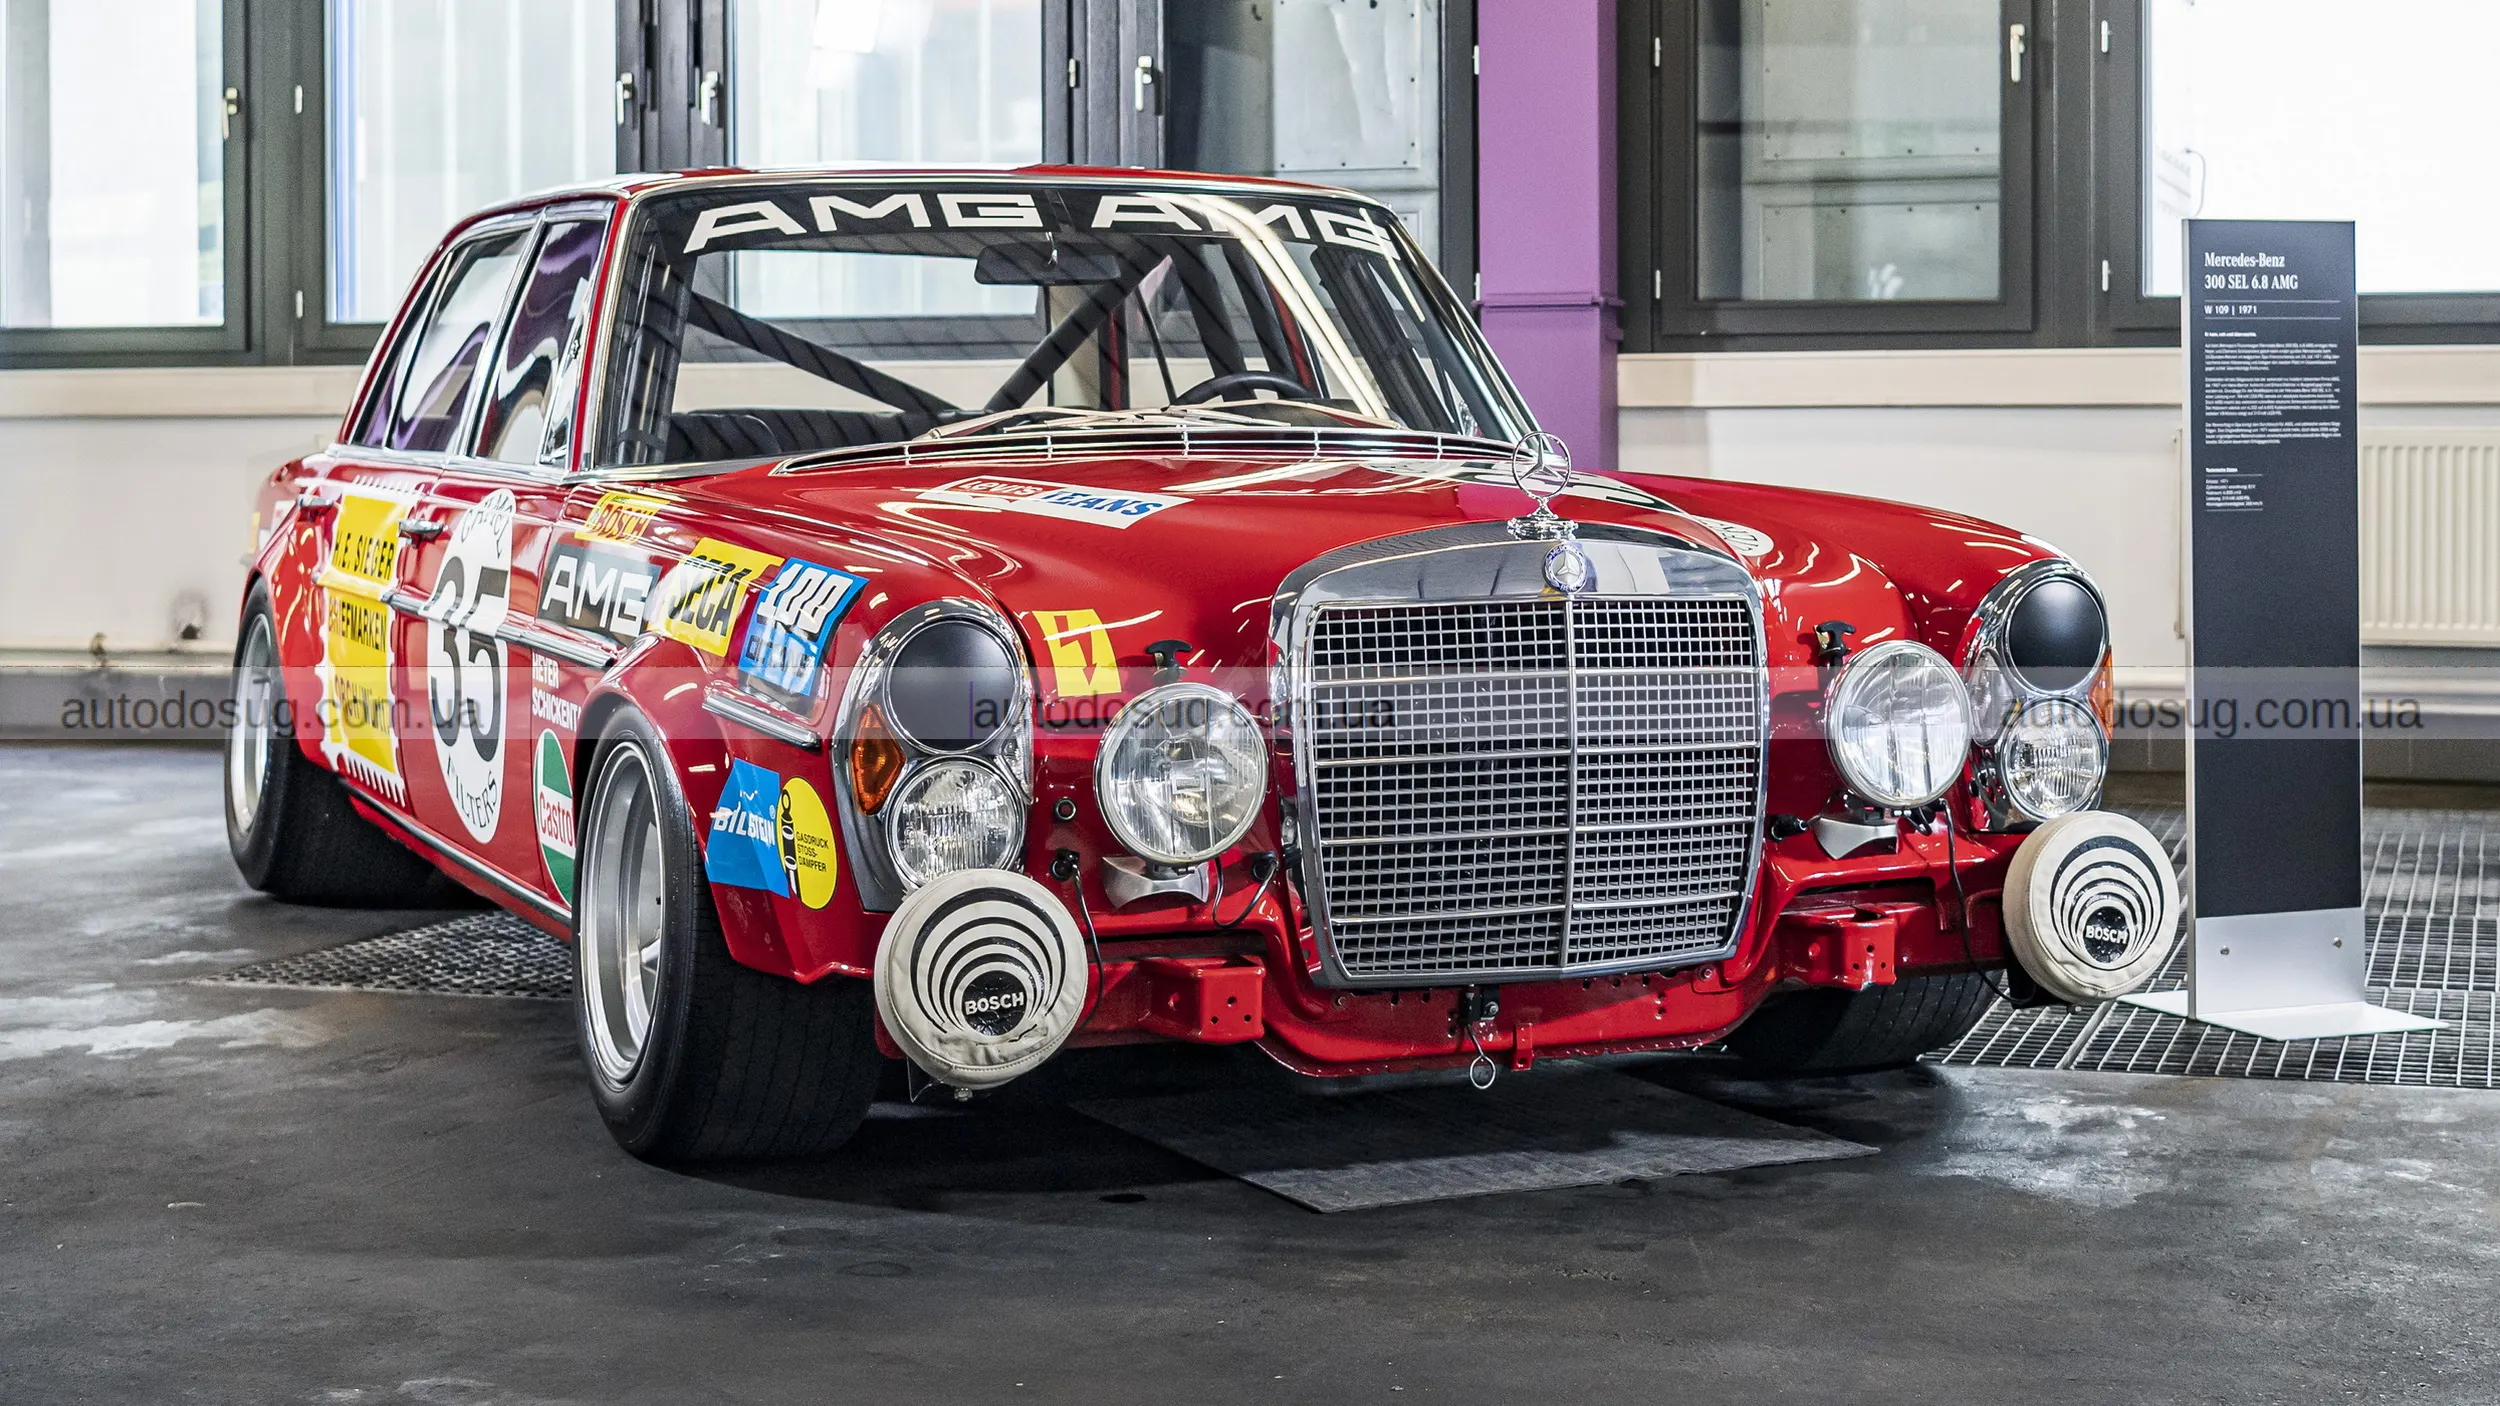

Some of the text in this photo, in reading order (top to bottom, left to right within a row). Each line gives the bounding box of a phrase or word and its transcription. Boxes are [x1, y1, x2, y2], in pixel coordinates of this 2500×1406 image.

[683, 193, 1401, 261] AMG AMG
[2204, 252, 2285, 268] Mercedes-Benz
[2204, 274, 2299, 290] 300 SEL 6.8 AMG
[2204, 305, 2213, 315] W
[2215, 305, 2229, 315] 109
[2238, 305, 2257, 315] 1971
[592, 503, 653, 541] BOSCH
[354, 534, 395, 581] SIEGER
[542, 555, 654, 638] AMG
[756, 562, 854, 635] 100
[424, 556, 508, 762] 35
[540, 791, 573, 847] Castro
[796, 831, 829, 849] GASDRUCK
[2085, 925, 2129, 945] BOSCH
[964, 991, 1025, 1016] BOSCH
